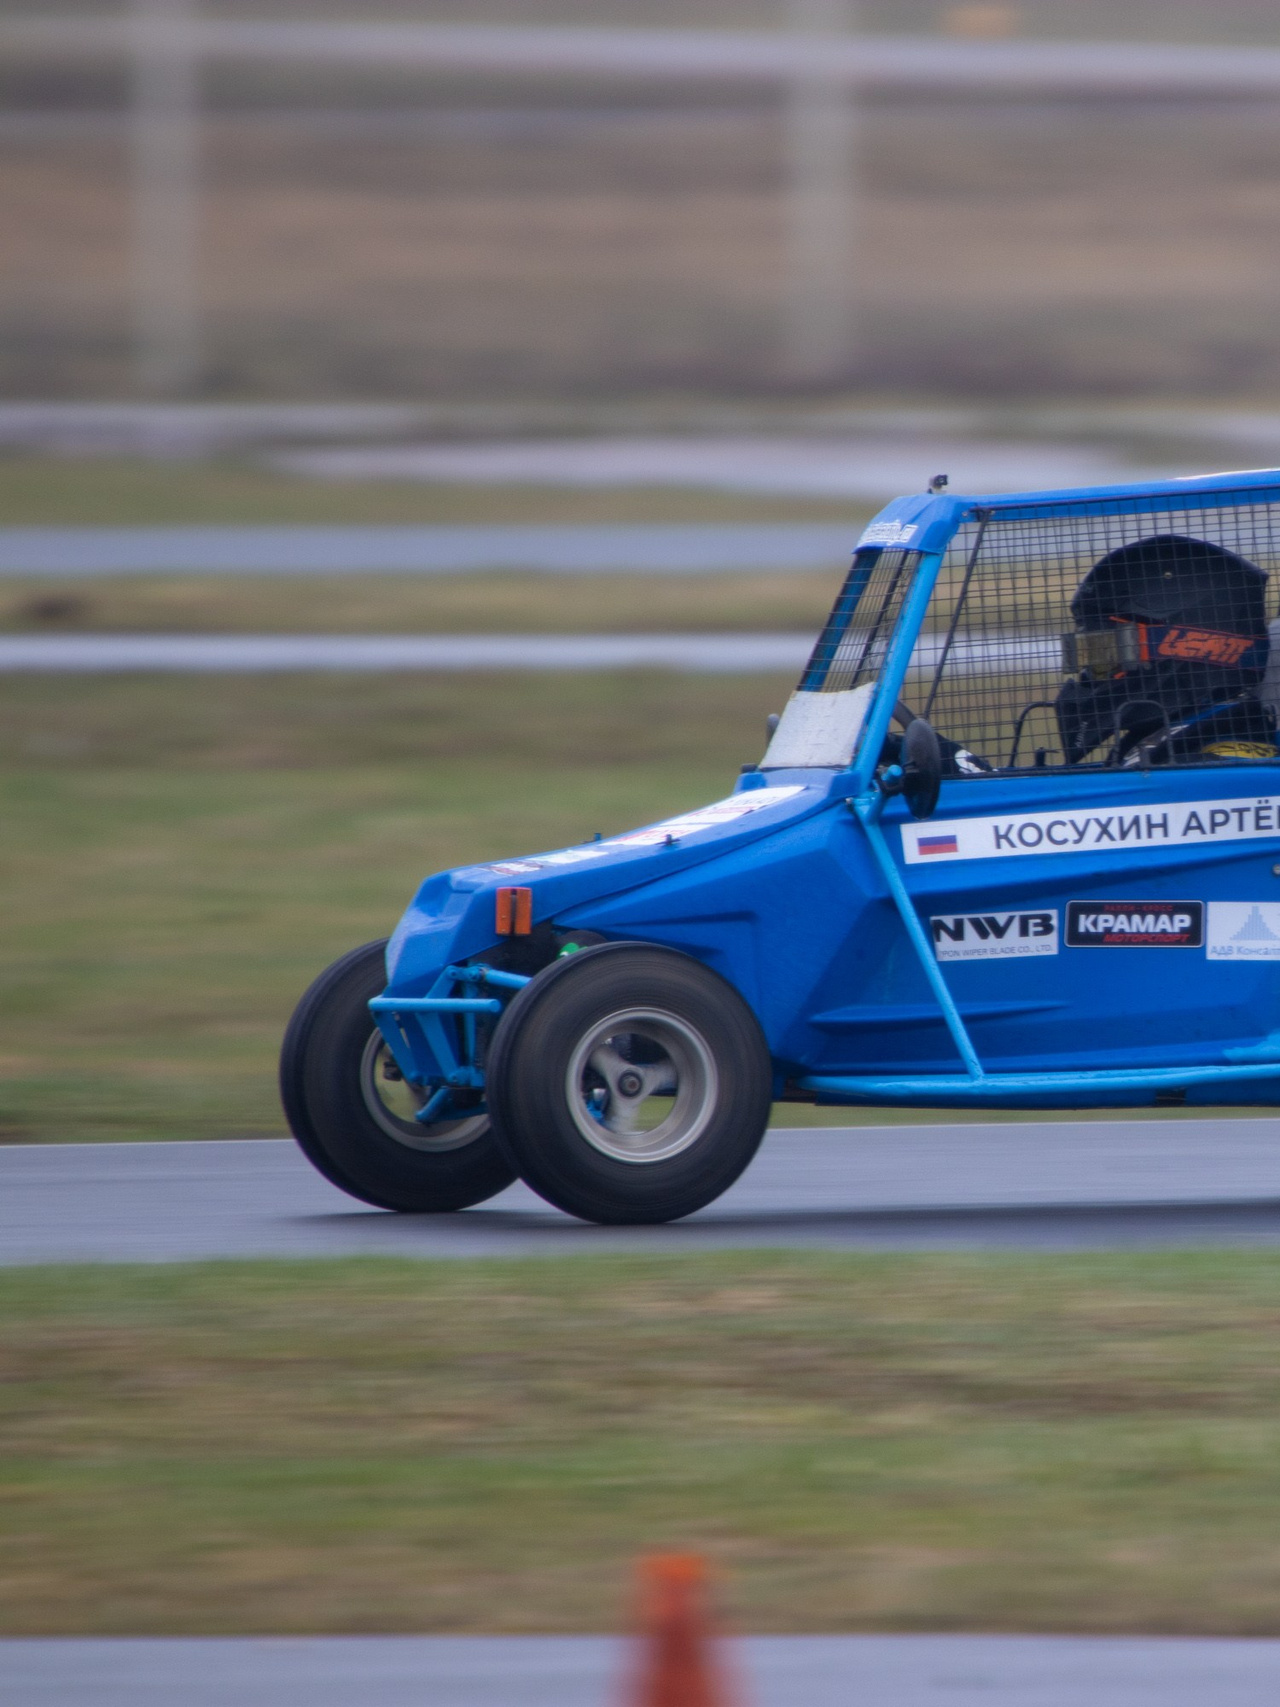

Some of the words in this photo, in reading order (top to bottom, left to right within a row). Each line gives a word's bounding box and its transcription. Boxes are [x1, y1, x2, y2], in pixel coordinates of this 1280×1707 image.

[993, 813, 1168, 849] КОСУХИН
[933, 913, 1054, 942] NWB
[1078, 913, 1192, 933] КРАМАР
[962, 948, 987, 956] WIPER
[990, 946, 1016, 955] BLADE
